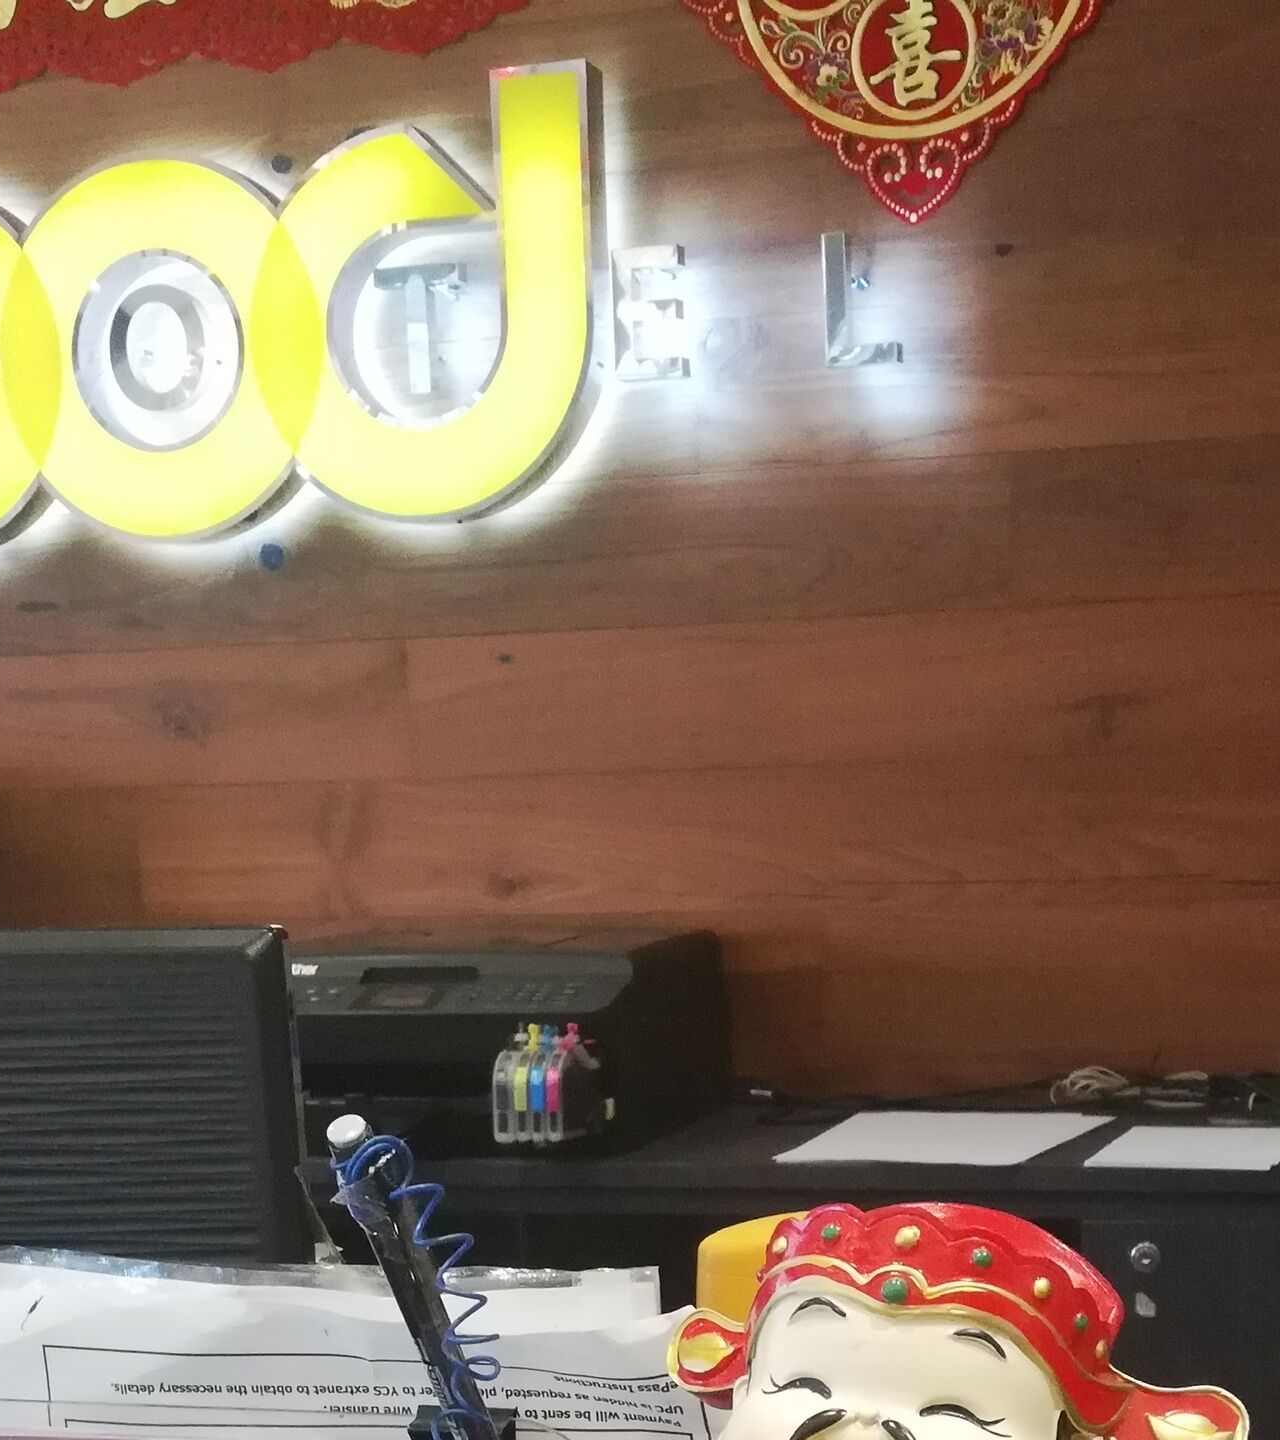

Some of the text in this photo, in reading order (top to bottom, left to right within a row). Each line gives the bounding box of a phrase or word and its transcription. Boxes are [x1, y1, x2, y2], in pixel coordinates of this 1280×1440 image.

[869, 0, 963, 107] 喜
[291, 963, 319, 976] ther
[110, 1382, 155, 1395] details.
[158, 1382, 223, 1396] necessary
[553, 1374, 635, 1392] Instructions
[225, 1384, 248, 1396] the
[250, 1383, 293, 1396] obtain
[296, 1384, 310, 1396] to
[313, 1384, 371, 1396] extranet
[373, 1384, 400, 1397] YCS
[402, 1385, 417, 1397] to
[500, 1387, 572, 1399] requested,
[524, 1409, 539, 1419] to
[541, 1409, 572, 1419] sent
[574, 1409, 591, 1421] be
[596, 1409, 620, 1421] will
[653, 1404, 685, 1416] UPC
